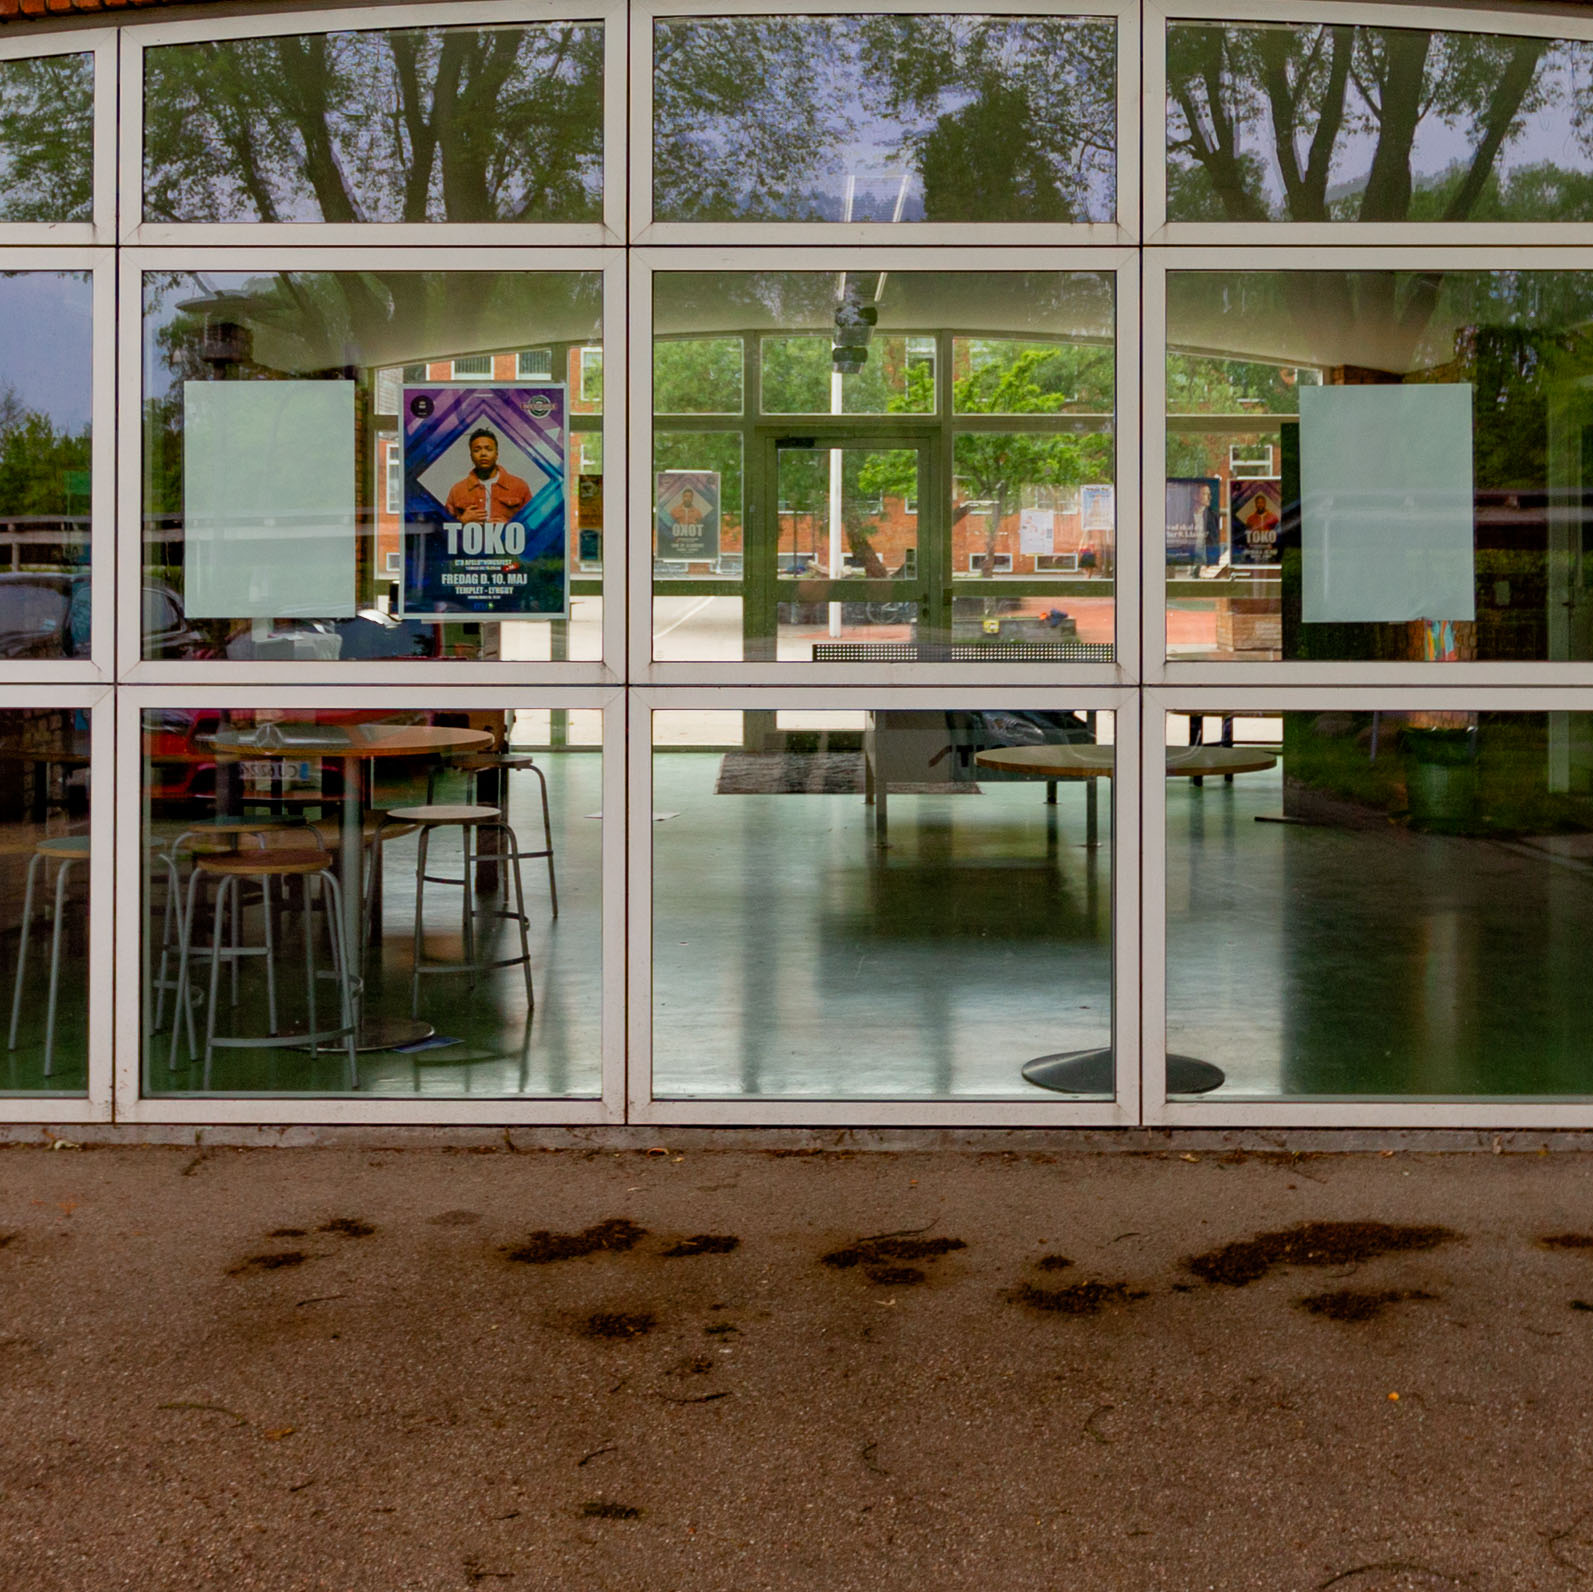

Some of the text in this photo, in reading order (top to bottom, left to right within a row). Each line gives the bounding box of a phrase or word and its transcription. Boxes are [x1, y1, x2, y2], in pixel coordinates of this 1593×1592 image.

[443, 522, 526, 556] TOKO
[1245, 530, 1277, 544] TOKO
[441, 573, 528, 585] FREDAG D. 10. MAJ
